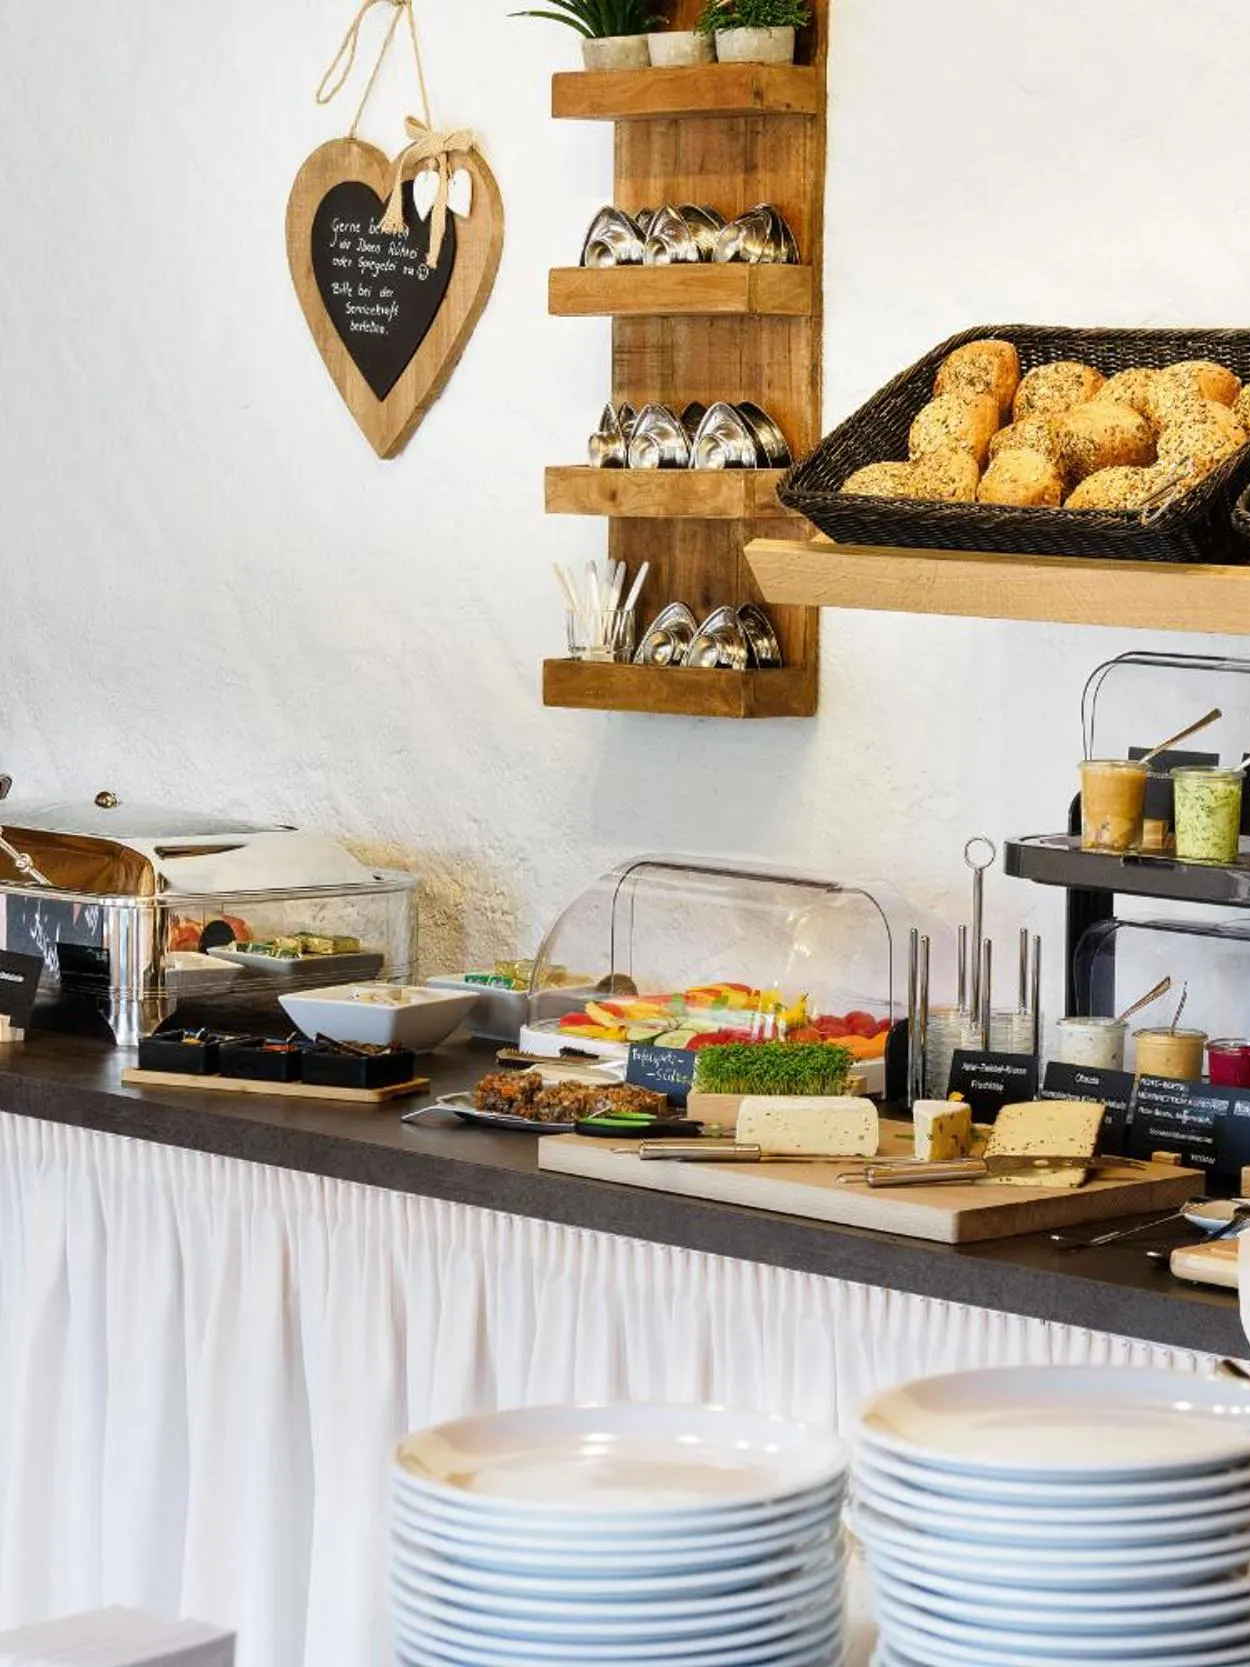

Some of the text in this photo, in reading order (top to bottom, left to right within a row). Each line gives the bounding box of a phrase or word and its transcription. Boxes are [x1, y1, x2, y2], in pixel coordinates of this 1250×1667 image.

[330, 218, 361, 247] Gerne
[332, 256, 352, 268] oder
[358, 256, 398, 277] Spiegelei
[331, 281, 394, 297] Bitte bei der
